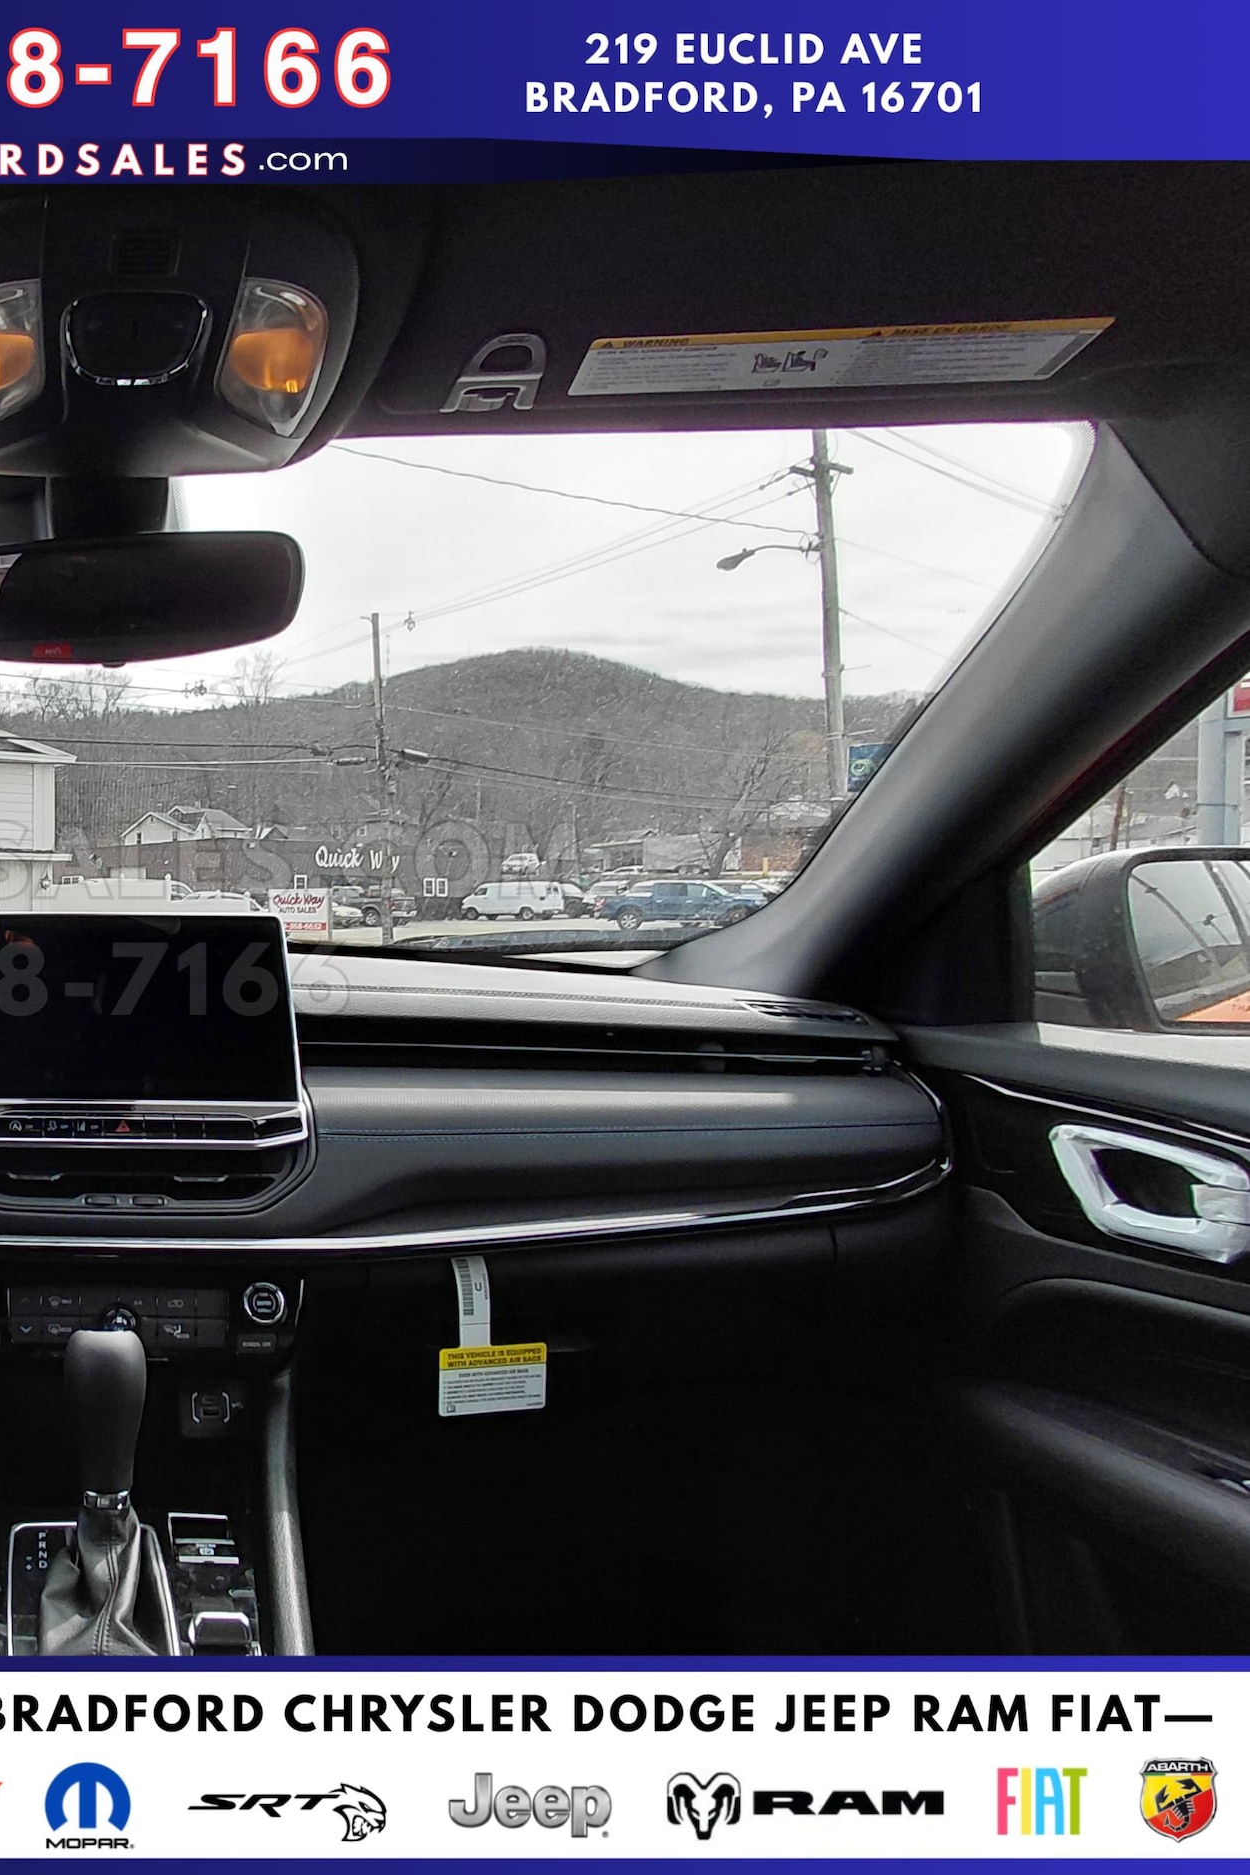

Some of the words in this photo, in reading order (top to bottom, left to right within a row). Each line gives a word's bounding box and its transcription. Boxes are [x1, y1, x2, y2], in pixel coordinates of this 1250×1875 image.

[623, 338, 690, 348] WARNING
[314, 843, 364, 868] Quick
[369, 848, 400, 874] Wy
[272, 892, 303, 908] Quick
[303, 892, 325, 909] Way
[466, 1351, 496, 1359] VEHICLE
[506, 1347, 542, 1356] EQUIPPED
[447, 1360, 467, 1368] WITH
[468, 1358, 508, 1367] ADVANCED
[523, 1355, 542, 1363] BAGS
